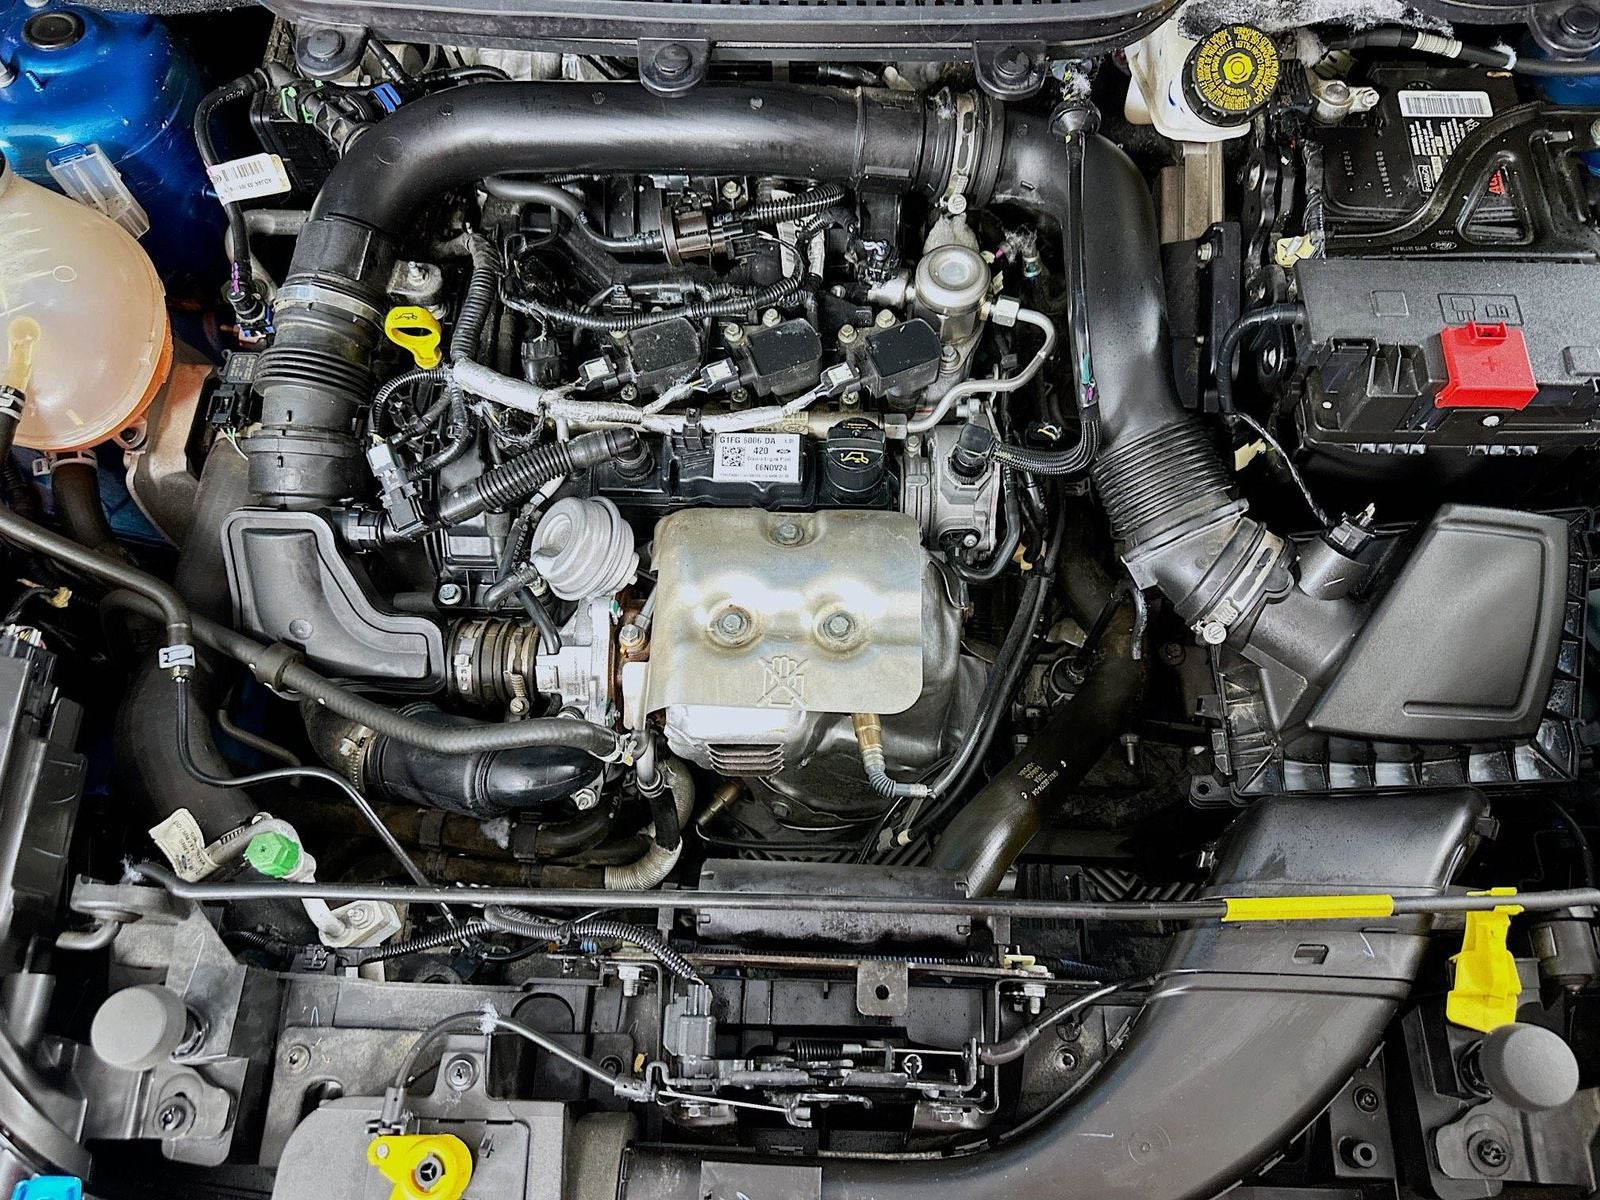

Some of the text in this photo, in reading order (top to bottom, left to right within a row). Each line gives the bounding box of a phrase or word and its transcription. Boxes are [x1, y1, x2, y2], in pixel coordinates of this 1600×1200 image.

[1234, 27, 1262, 40] CONTAINER
[1200, 41, 1212, 56] AVANT
[1235, 42, 1252, 51] FILLER
[1249, 38, 1259, 47] USE
[1251, 47, 1264, 64] CLEAN
[1219, 84, 1247, 96] PROVENANT
[1266, 77, 1278, 93] FLUID
[1203, 87, 1224, 106] NETTOYER
[1253, 93, 1265, 104] DOT
[1224, 102, 1250, 110] ATTENTION
[1422, 166, 1433, 192] FoMoCo
[719, 436, 740, 444] G1FG
[764, 437, 776, 445] DA
[753, 446, 769, 455] 420
